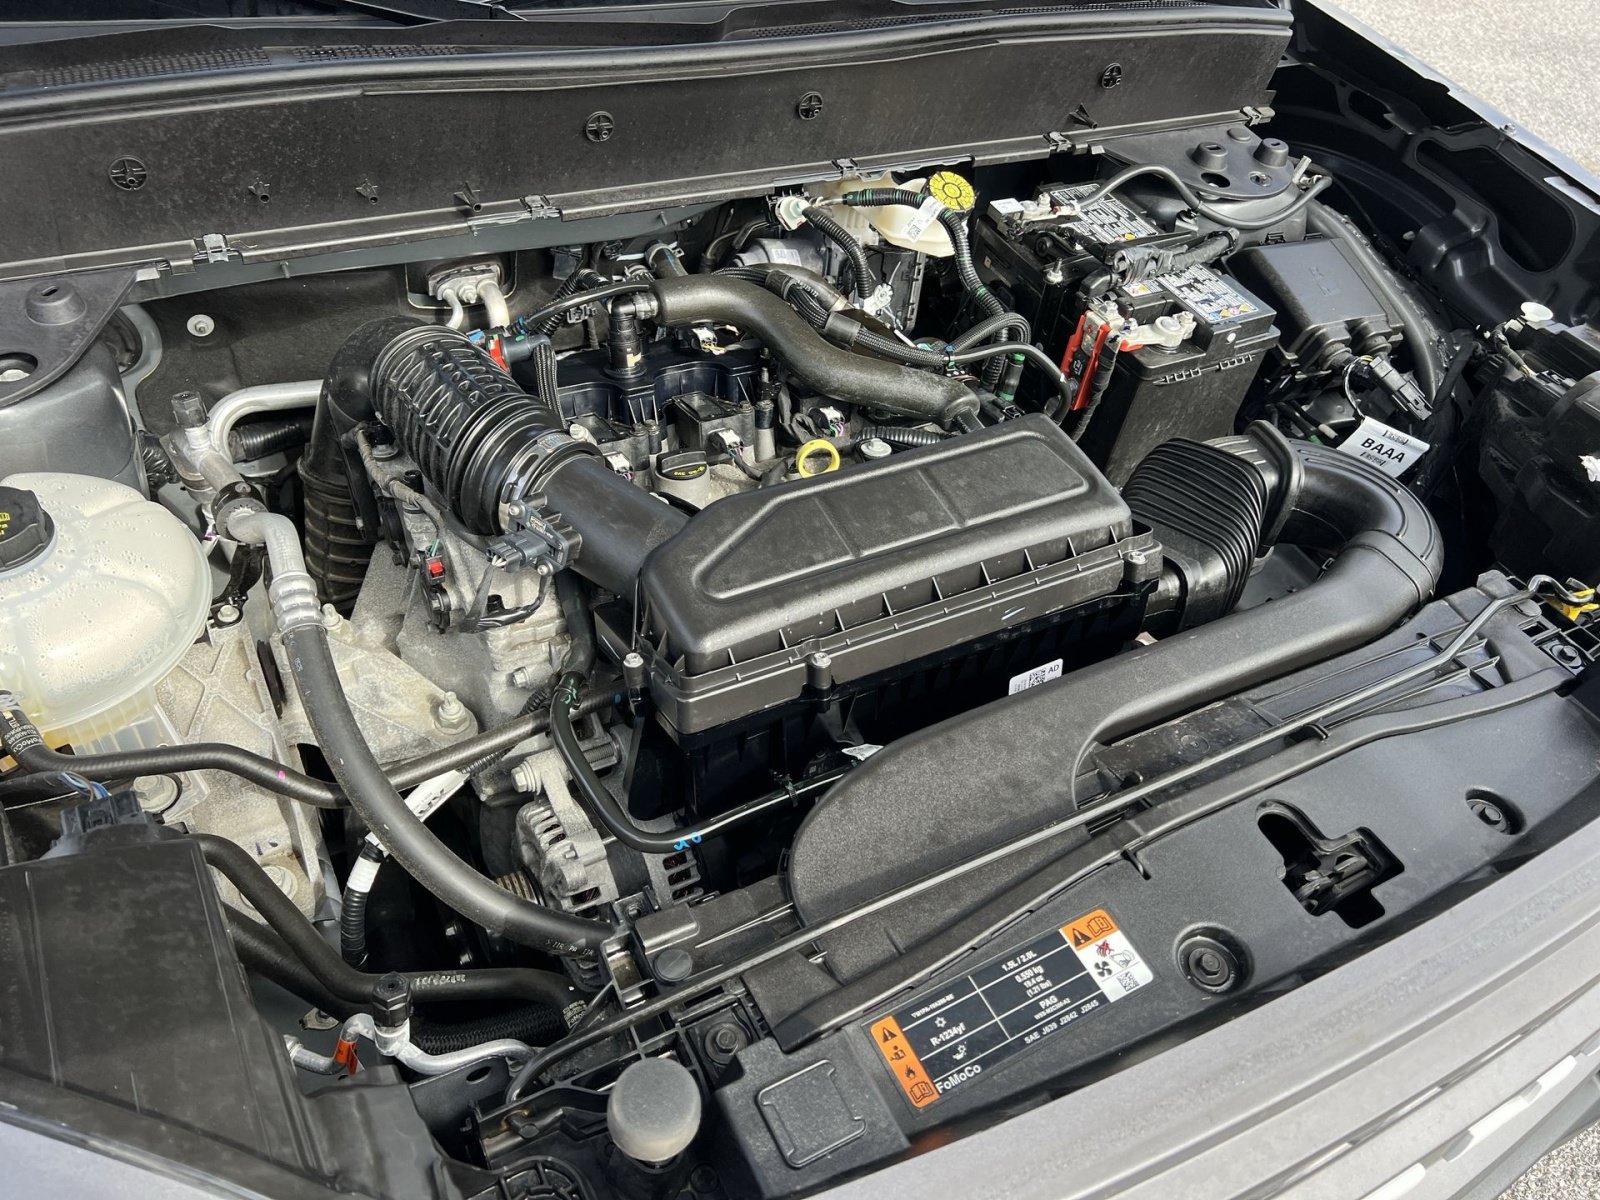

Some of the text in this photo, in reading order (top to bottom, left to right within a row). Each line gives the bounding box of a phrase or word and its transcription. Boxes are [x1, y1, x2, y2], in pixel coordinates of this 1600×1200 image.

[1361, 437, 1405, 463] BAAA
[1047, 664, 1060, 673] AD
[1002, 961, 1018, 972] 1.5L
[1021, 950, 1037, 963] 2.0L
[1015, 964, 1044, 983] 0.550 kg
[1038, 994, 1058, 1009] PAG
[1024, 1000, 1099, 1044] SAE J639 J2842 J2845
[930, 1022, 965, 1047] R-1234yf
[935, 1064, 982, 1093] FoMoCo
